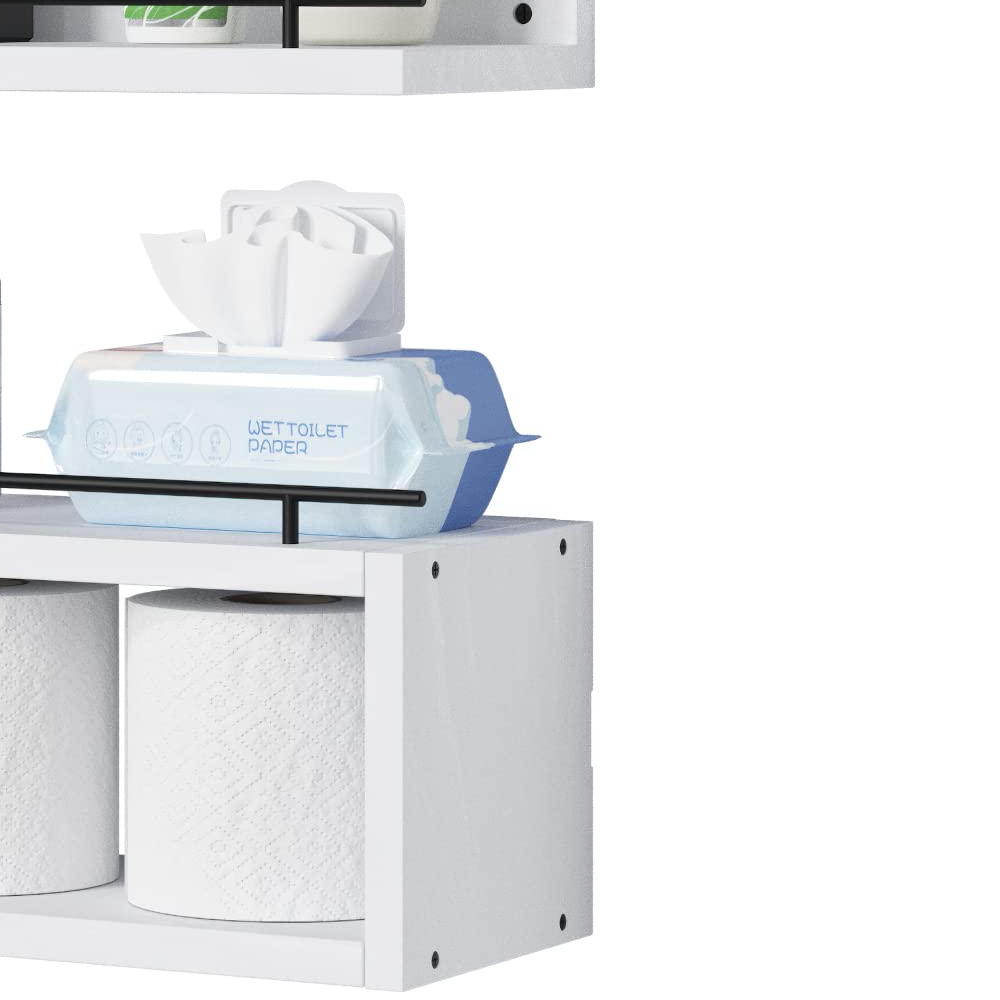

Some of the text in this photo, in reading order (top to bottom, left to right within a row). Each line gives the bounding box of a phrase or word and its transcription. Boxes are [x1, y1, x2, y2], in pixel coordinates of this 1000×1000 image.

[248, 419, 349, 439] WET TOILET
[248, 438, 308, 455] PAPER
